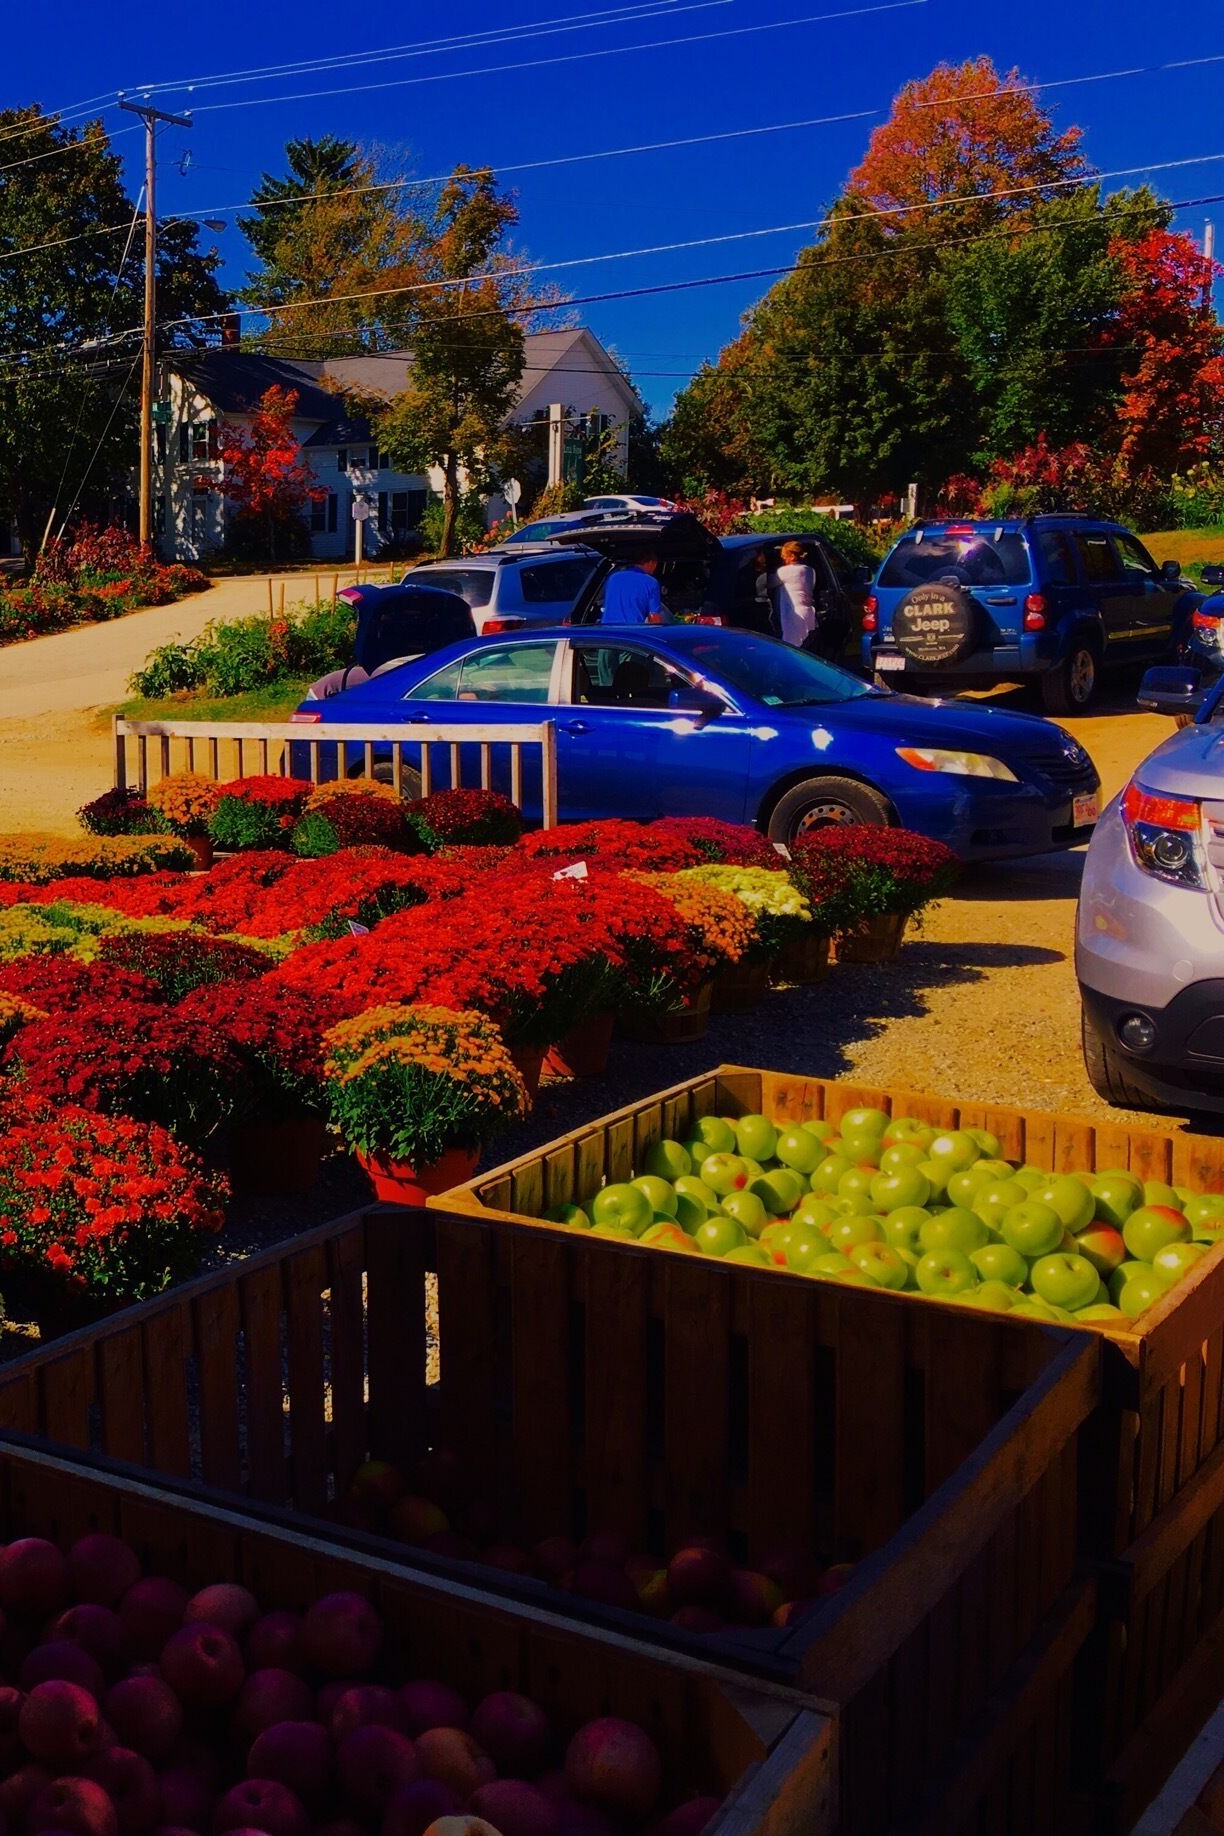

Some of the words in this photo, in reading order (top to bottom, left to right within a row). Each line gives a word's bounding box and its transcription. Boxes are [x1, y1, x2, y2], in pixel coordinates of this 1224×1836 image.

[912, 593, 929, 603] Only
[904, 602, 954, 617] CLARK
[911, 618, 949, 632] Jeep
